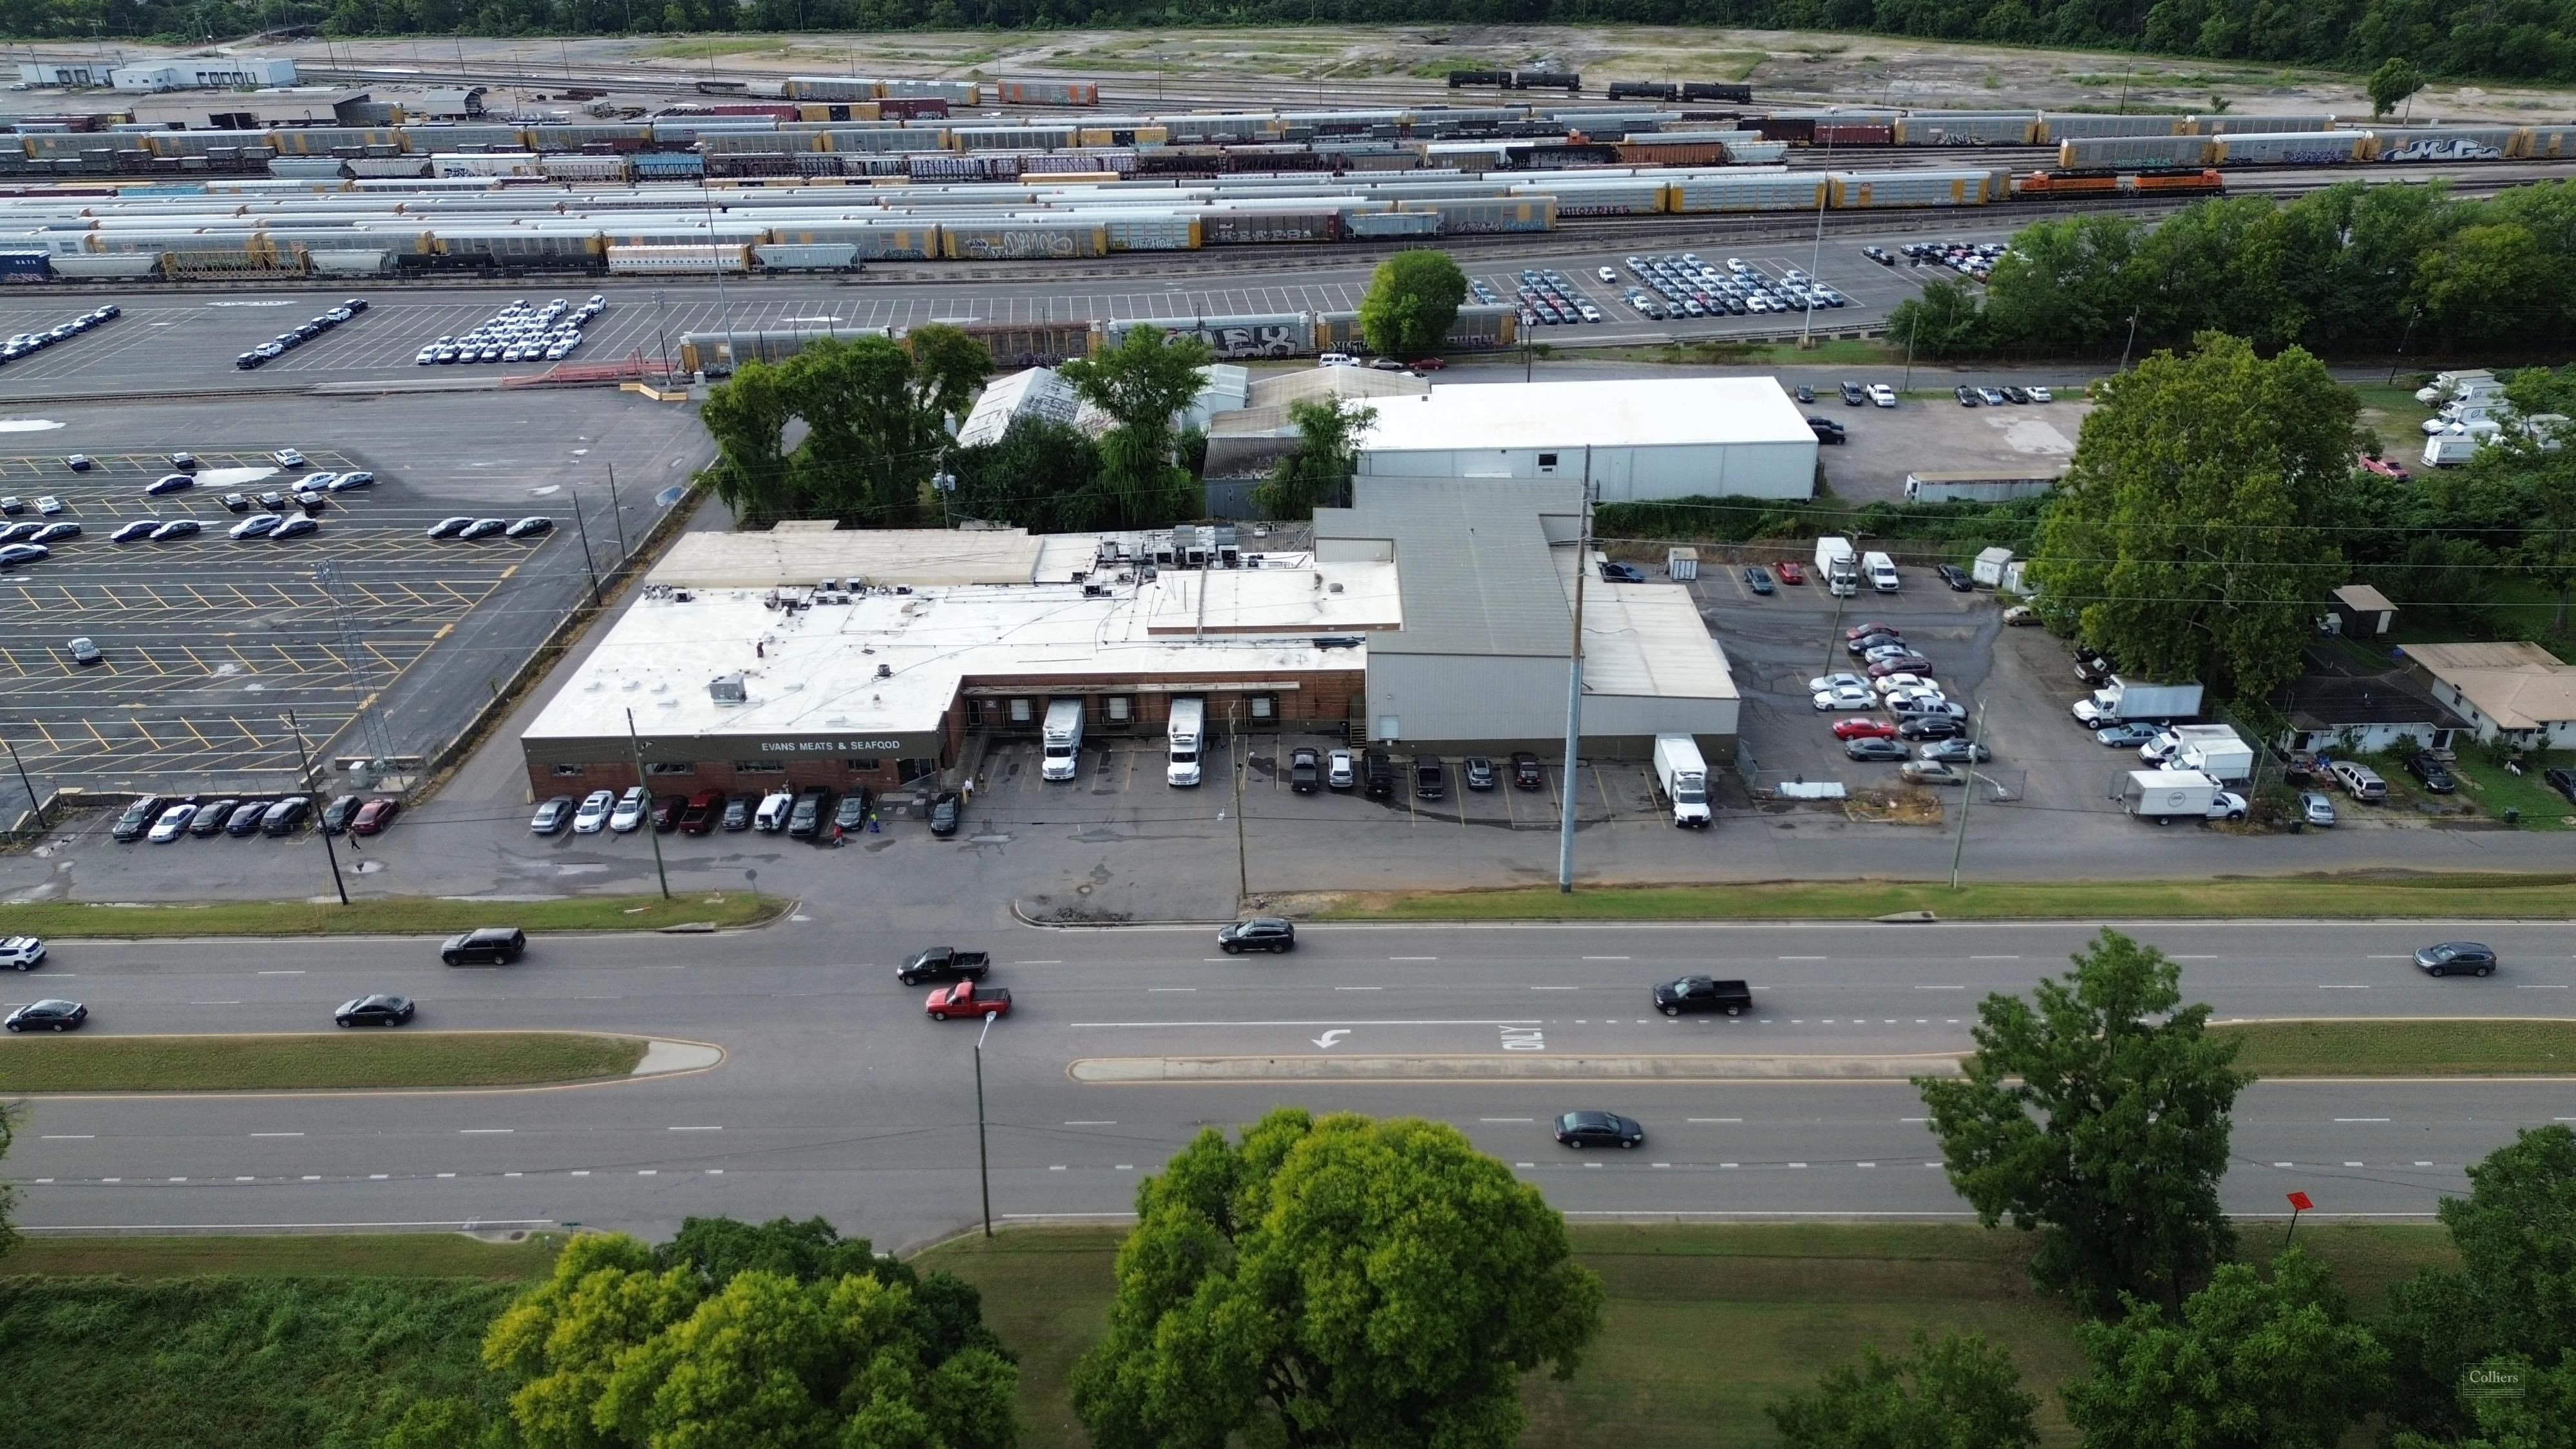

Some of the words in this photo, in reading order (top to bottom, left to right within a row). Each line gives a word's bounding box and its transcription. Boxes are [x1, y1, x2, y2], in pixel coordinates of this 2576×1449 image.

[762, 743, 796, 752] EVANS
[800, 742, 833, 751] MEATS
[838, 742, 847, 750] &
[1498, 1025, 1544, 1050] ONLY
